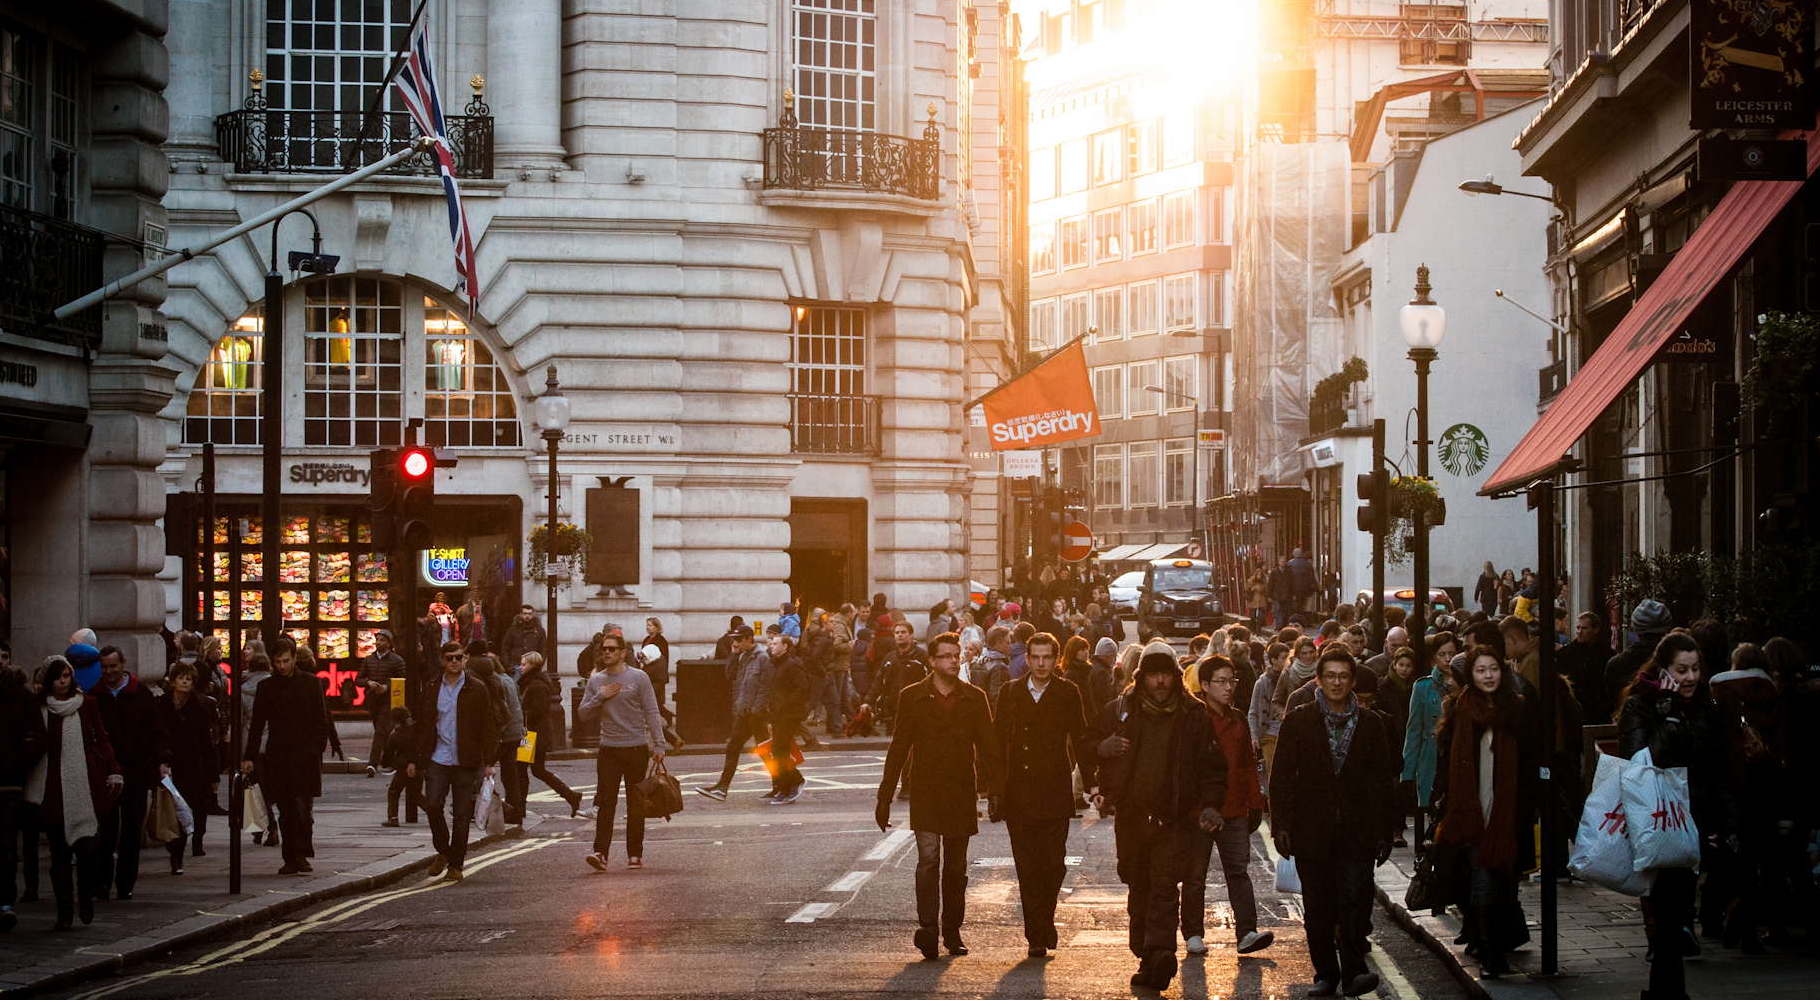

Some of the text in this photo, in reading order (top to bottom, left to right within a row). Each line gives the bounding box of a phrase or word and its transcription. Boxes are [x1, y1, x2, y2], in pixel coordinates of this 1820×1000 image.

[1715, 101, 1793, 111] LEICESTER
[1735, 113, 1776, 124] ARMS
[992, 408, 1093, 443] Superdry
[608, 434, 651, 444] STREET
[289, 464, 372, 487] Superdry
[430, 548, 466, 559] T-SHIRT
